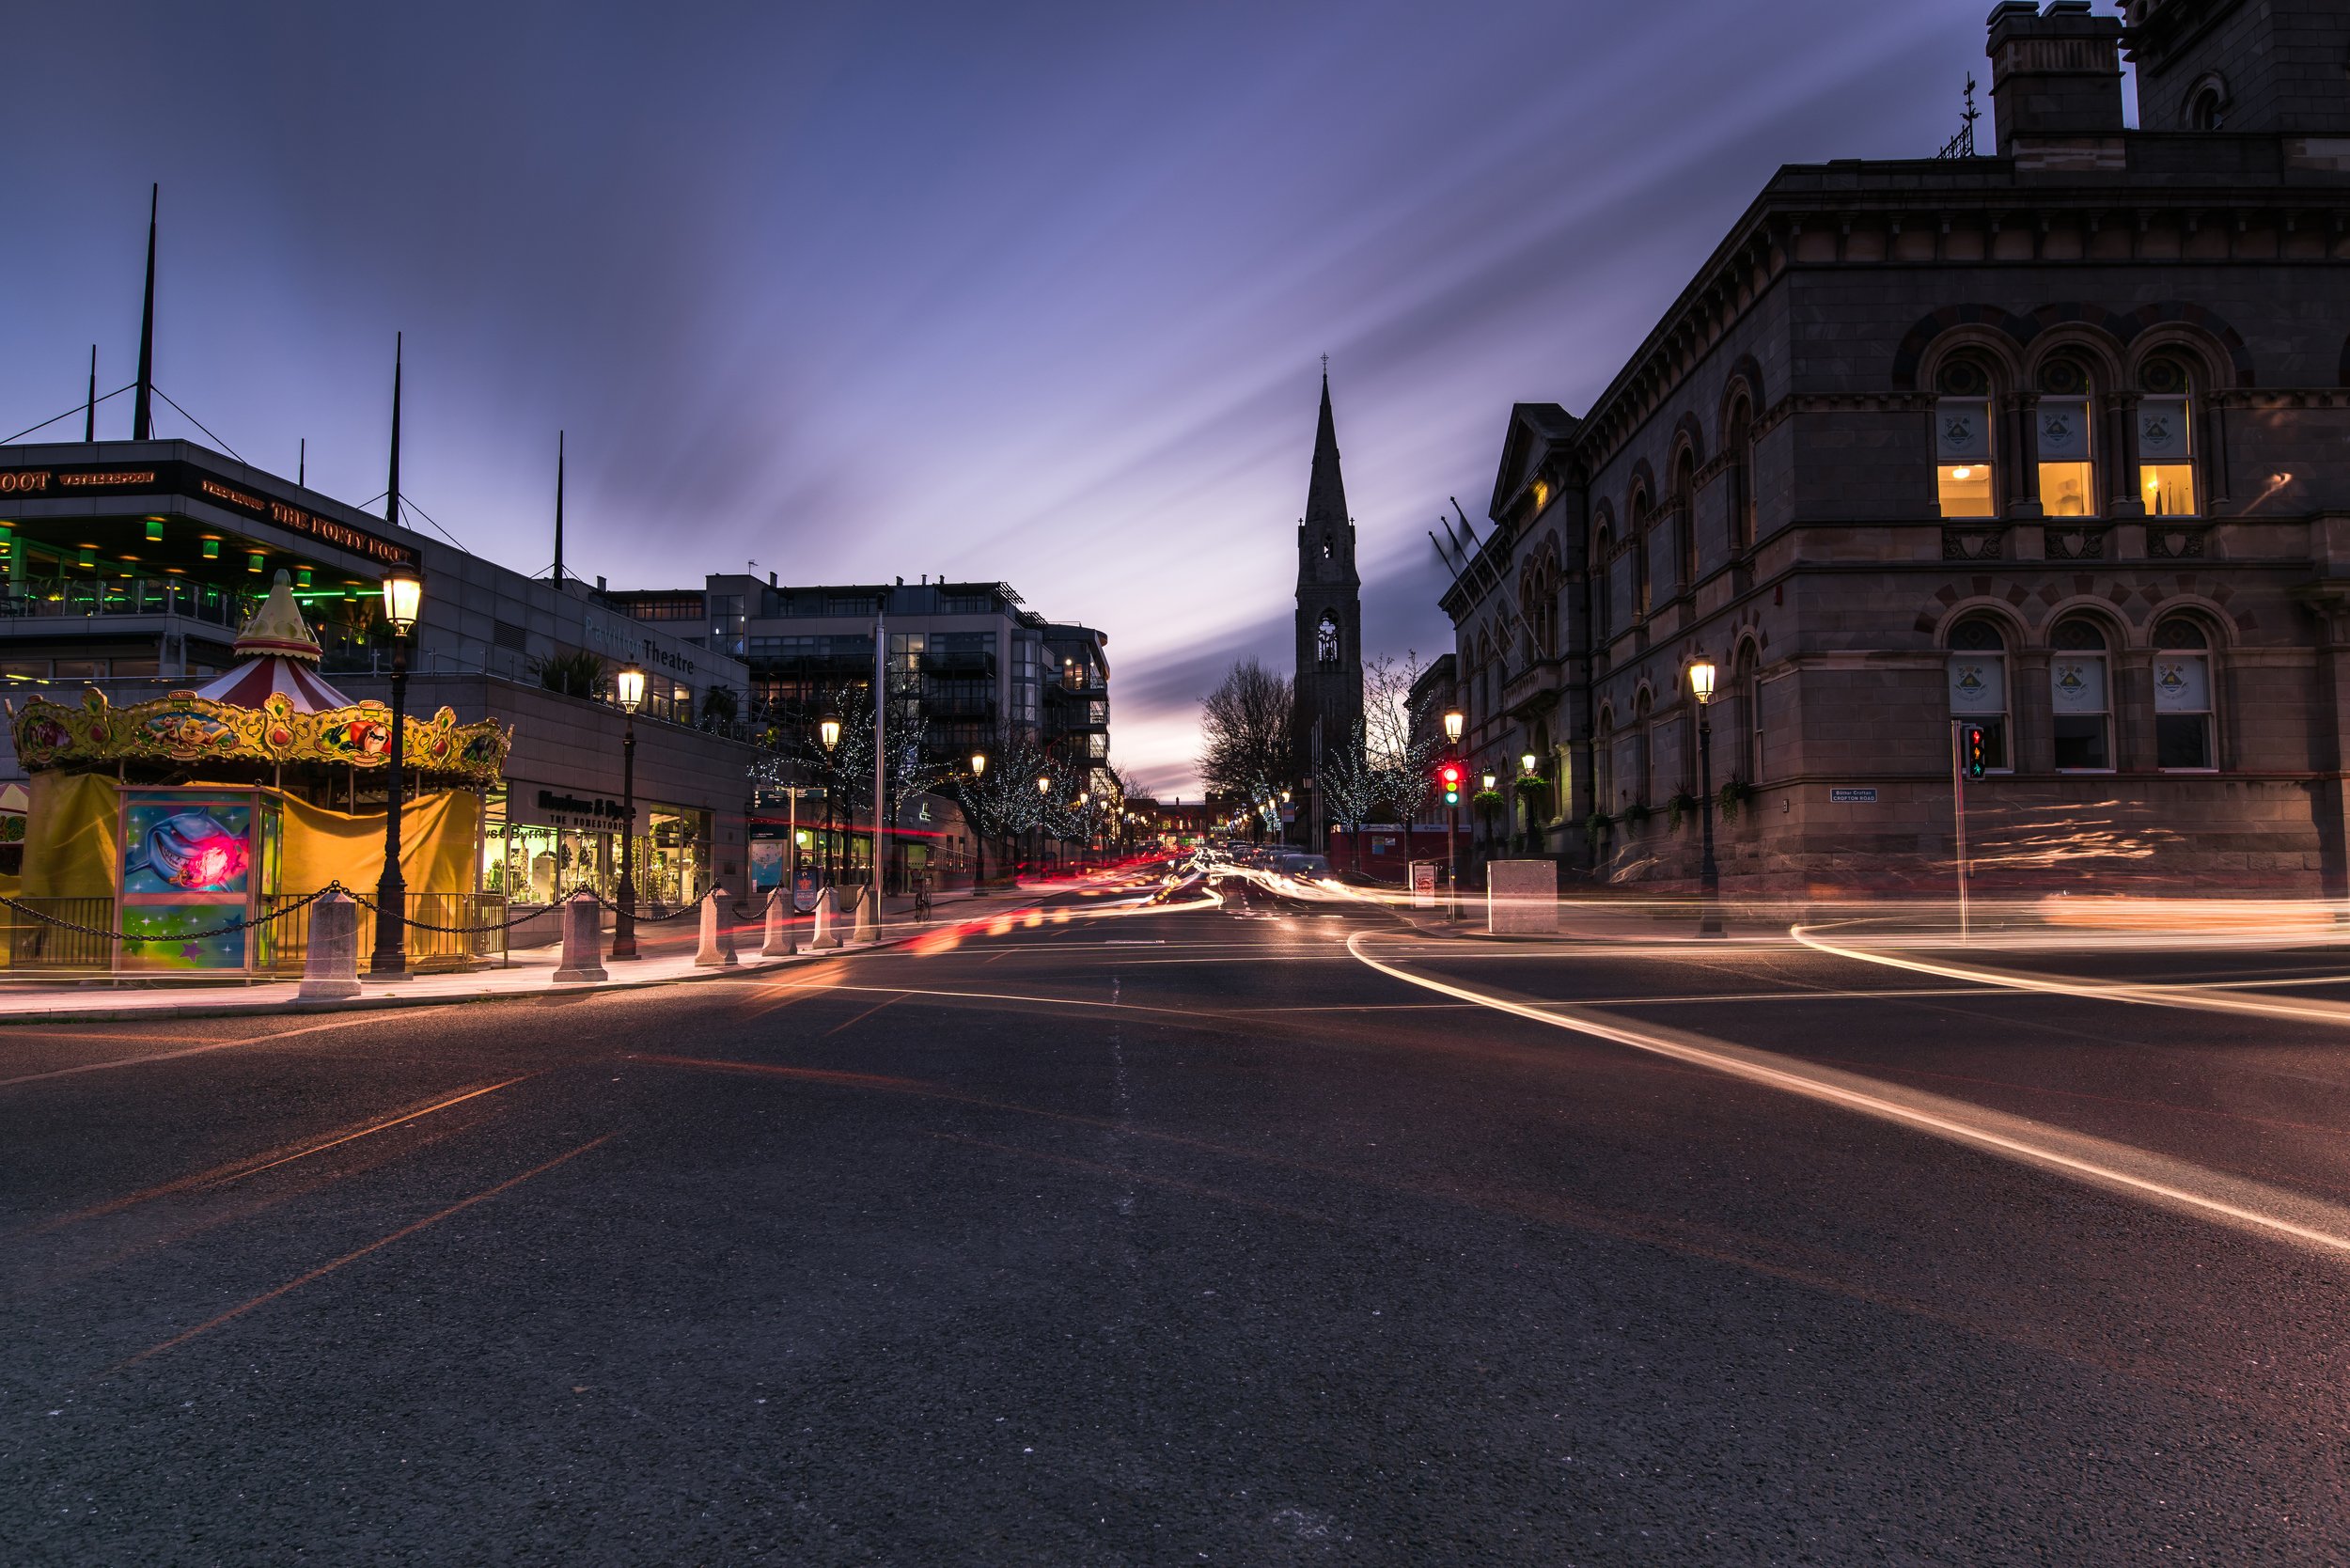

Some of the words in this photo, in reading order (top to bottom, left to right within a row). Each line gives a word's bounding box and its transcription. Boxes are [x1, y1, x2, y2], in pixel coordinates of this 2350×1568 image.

[0, 472, 52, 493] OOT
[58, 472, 155, 485] WETHERSPOON
[231, 491, 267, 511] HOUSE
[272, 501, 309, 530] THE
[311, 515, 368, 551] FORTY
[368, 537, 413, 563] FOOT
[644, 639, 695, 675] Theatre
[550, 815, 567, 824] THE
[574, 817, 624, 831] HOMESTORE
